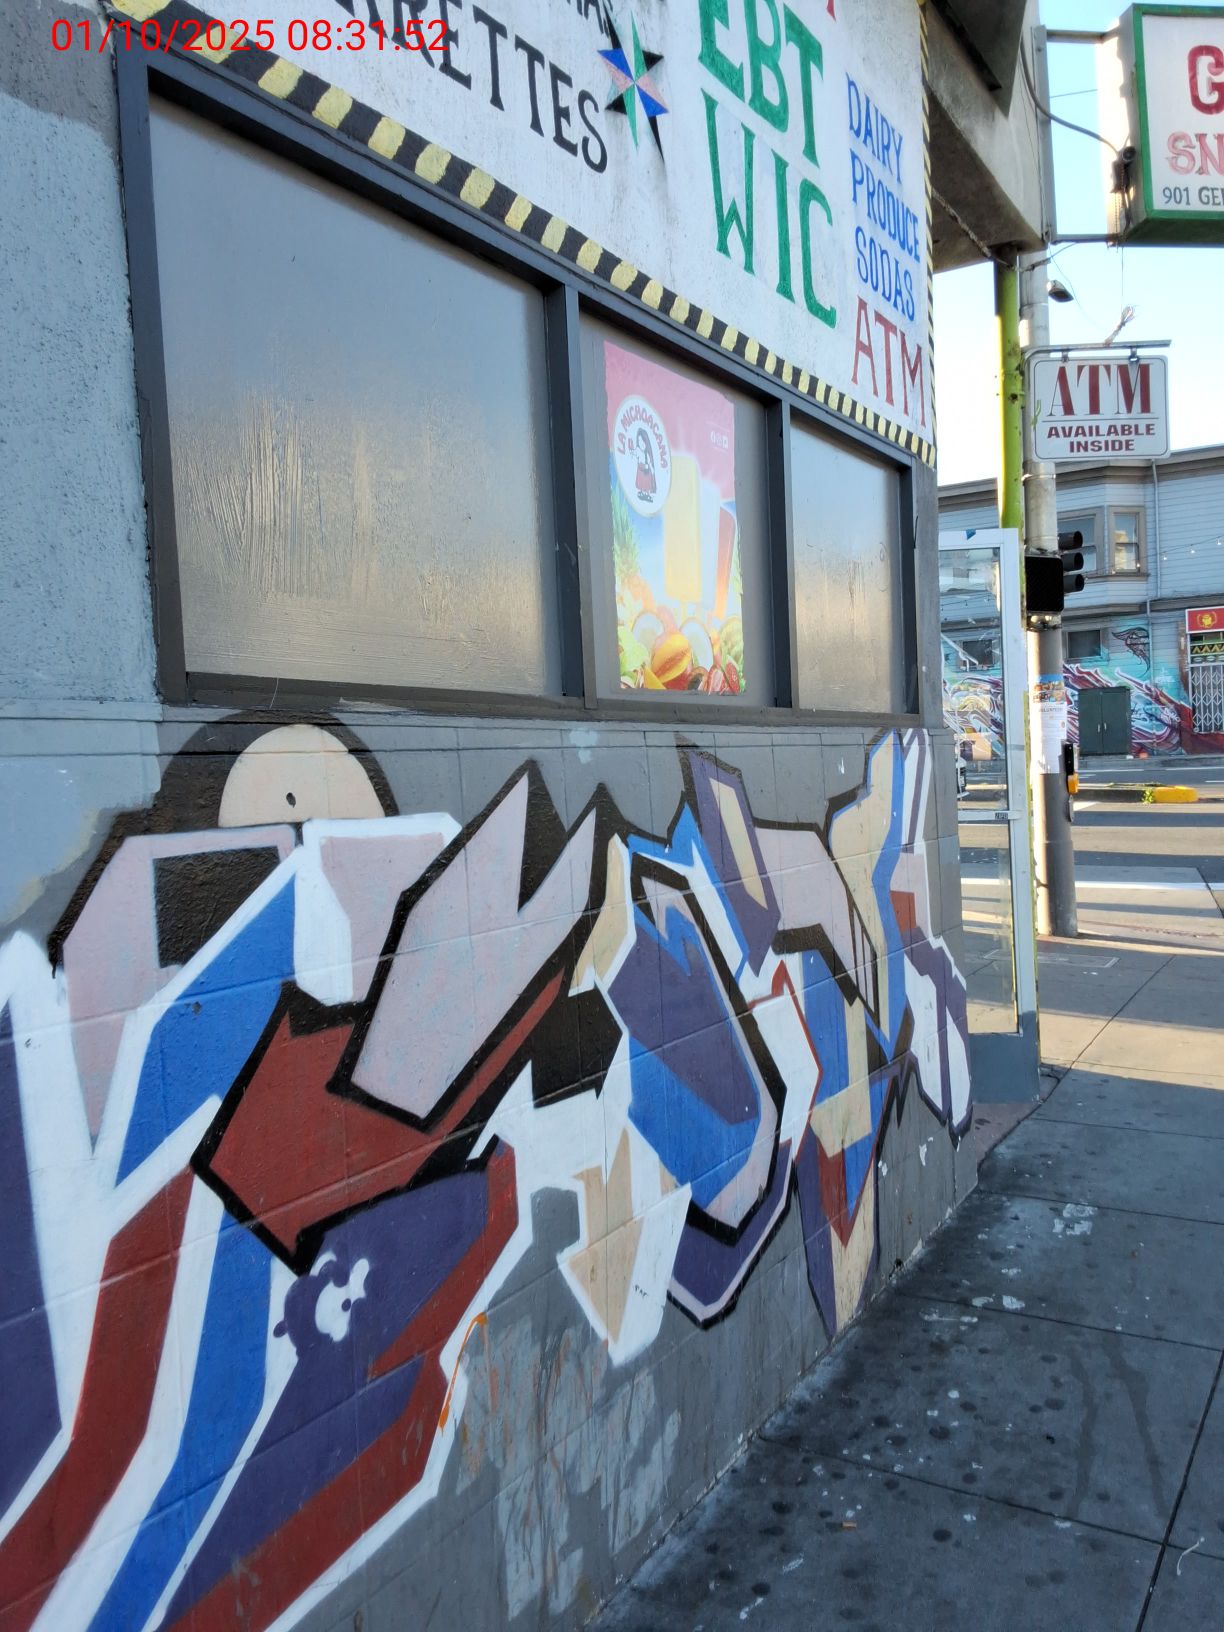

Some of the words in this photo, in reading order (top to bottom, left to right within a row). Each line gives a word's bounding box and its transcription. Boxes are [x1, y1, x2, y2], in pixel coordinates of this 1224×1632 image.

[697, 0, 824, 168] EBT
[846, 71, 903, 184] DAIRY
[700, 88, 837, 329] WIC
[850, 148, 921, 264] PRODUCE
[1162, 186, 1191, 206] 901
[1198, 186, 1224, 206] GE
[855, 226, 916, 322] SODAS
[851, 296, 927, 428] ATM
[1046, 363, 1154, 417] ATM
[1047, 423, 1156, 439] AVAILABLE
[1069, 439, 1135, 454] INSIDE
